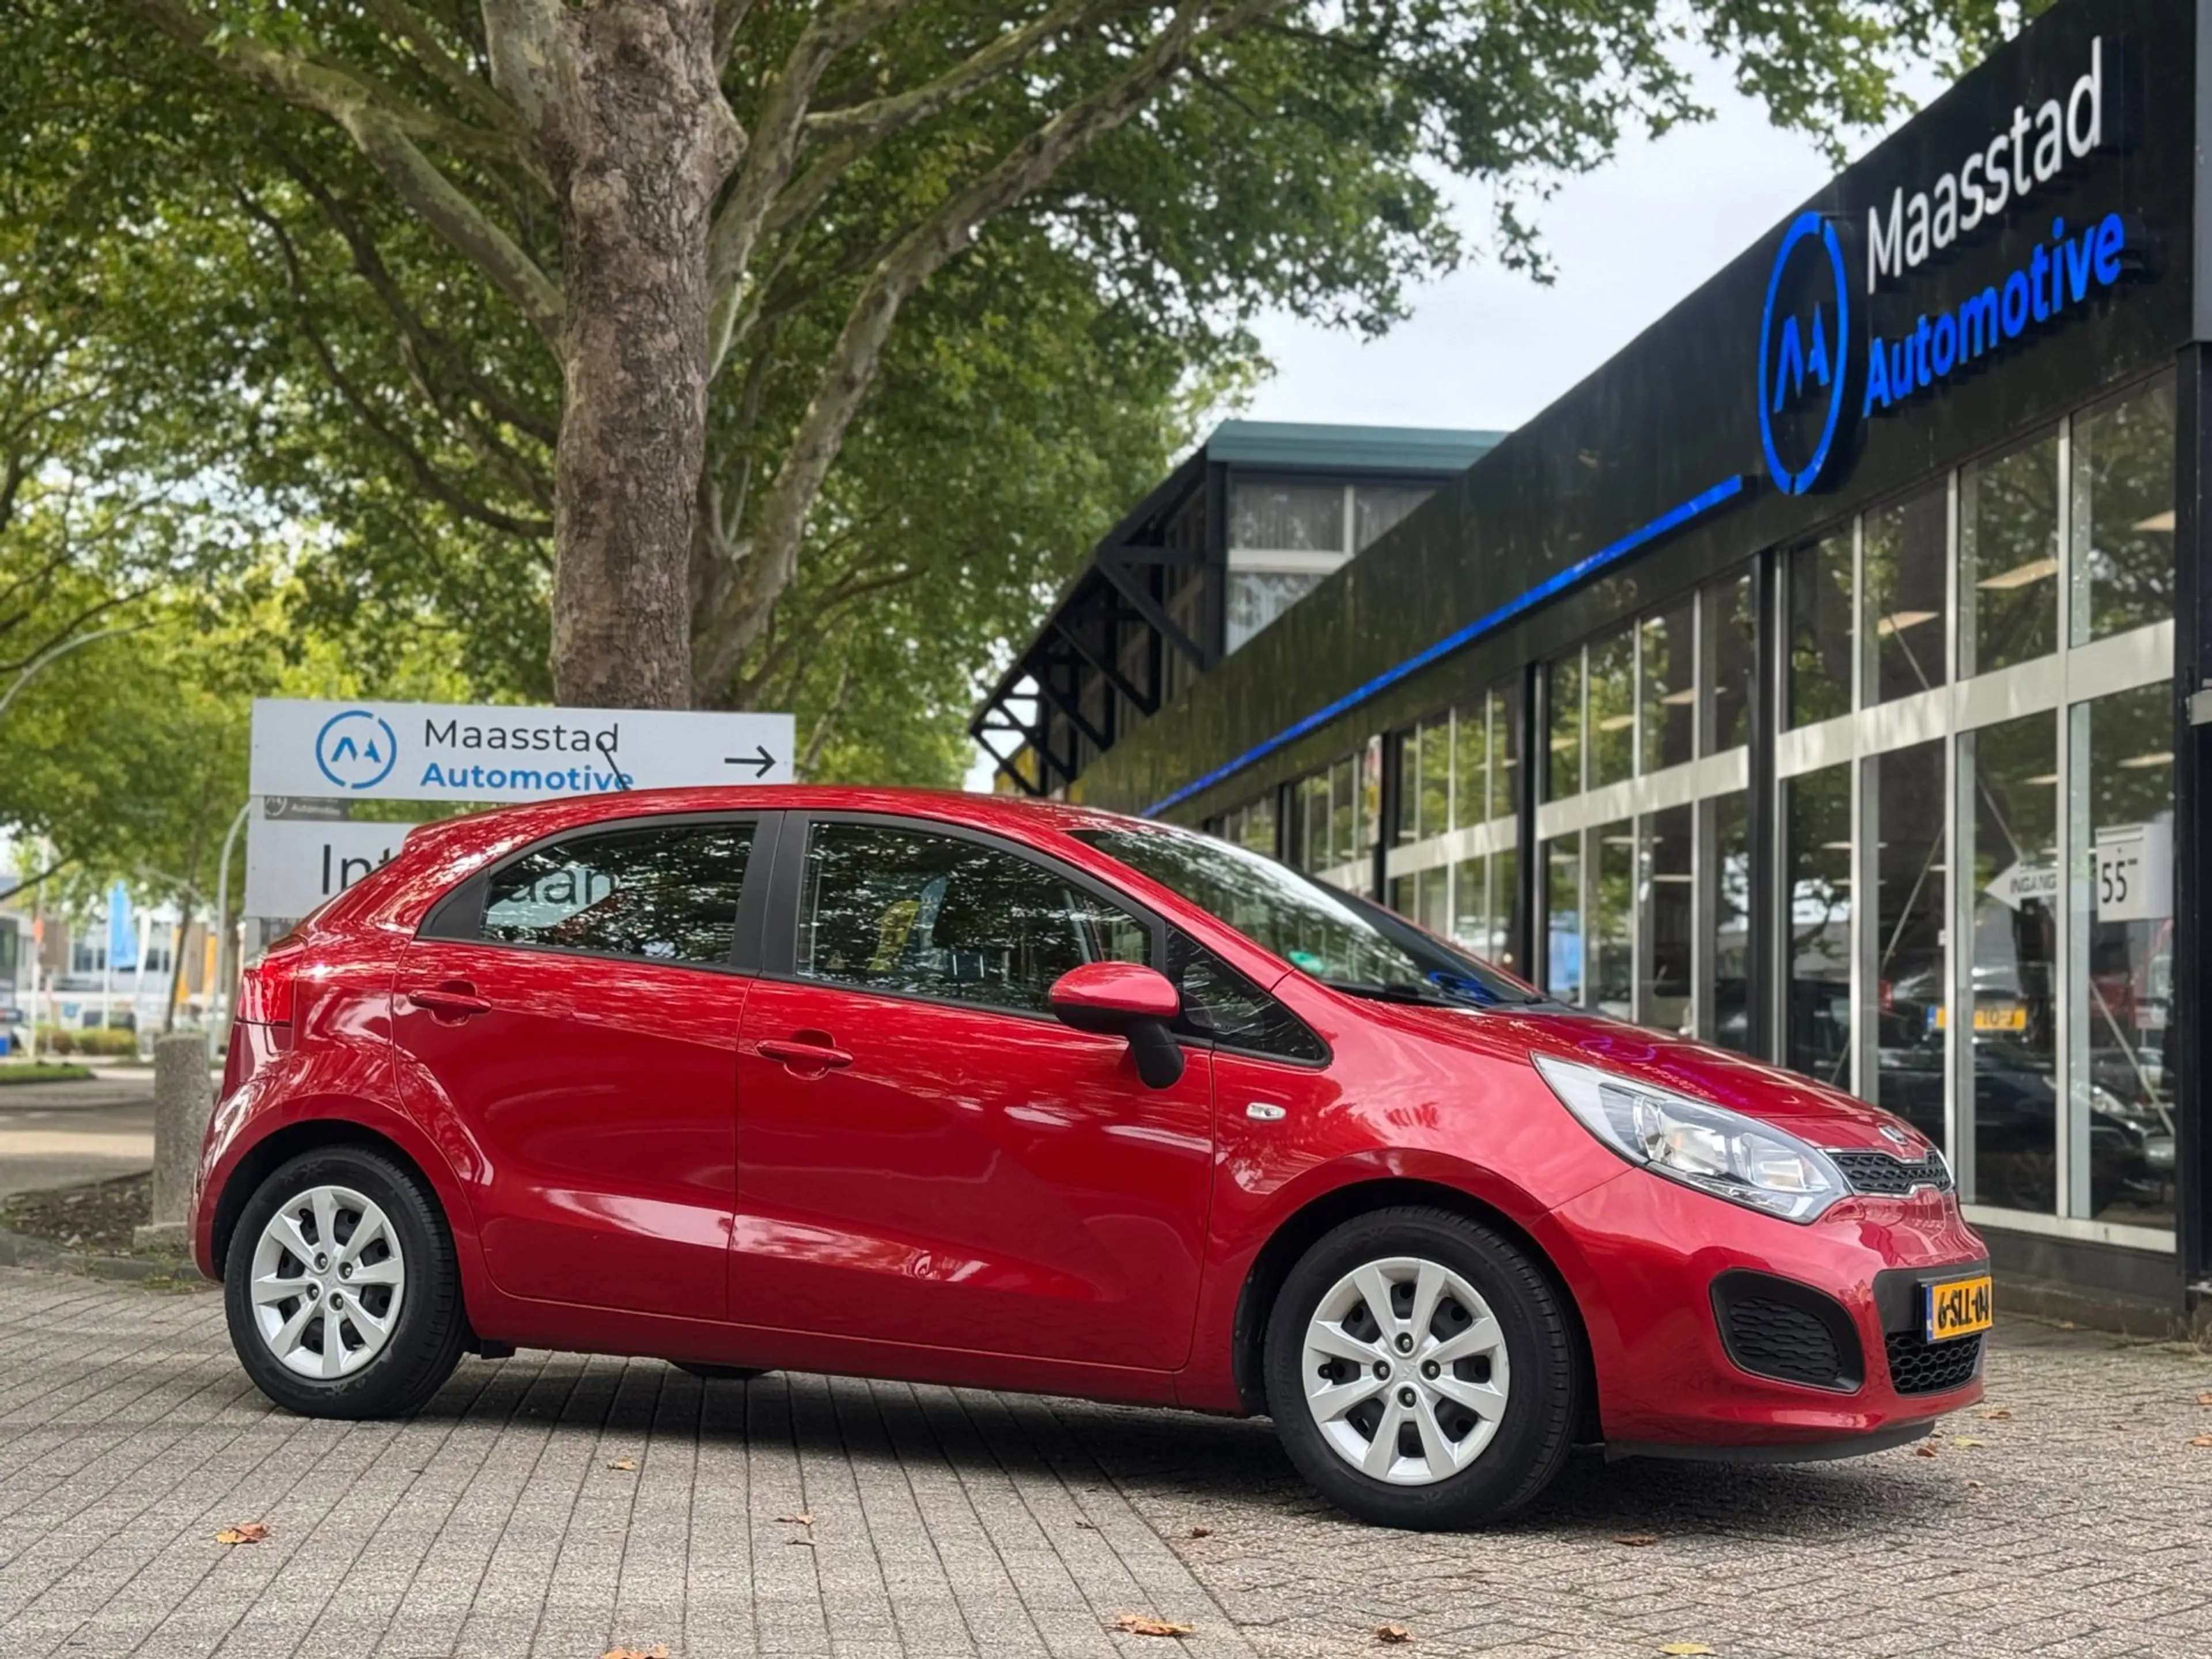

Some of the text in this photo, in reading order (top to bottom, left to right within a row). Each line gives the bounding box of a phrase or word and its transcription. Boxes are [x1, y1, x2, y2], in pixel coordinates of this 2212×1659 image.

[1867, 35, 2102, 295] Maasstad
[1862, 213, 2126, 418] Automotive
[419, 762, 634, 792] Automotive
[425, 718, 619, 753] Maasstad
